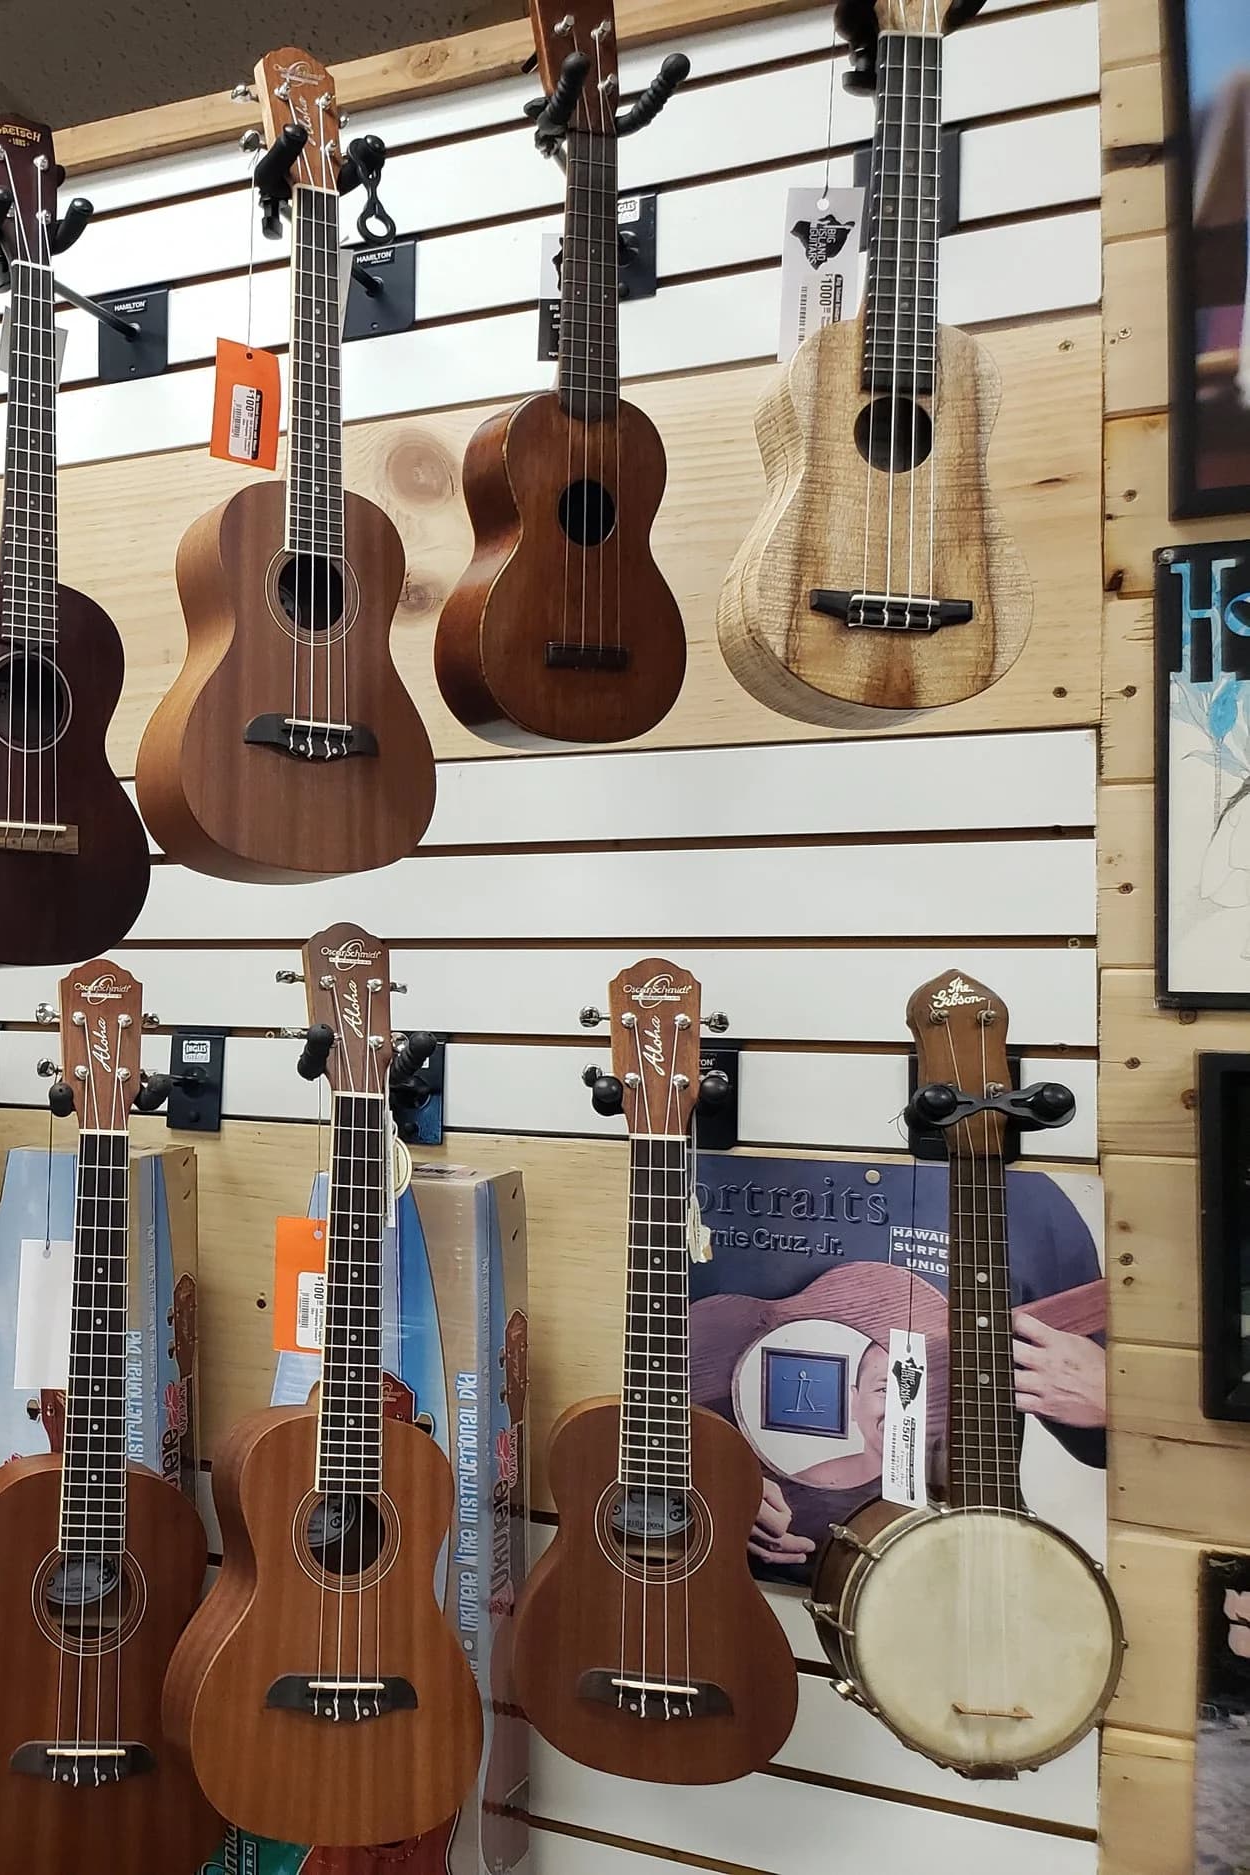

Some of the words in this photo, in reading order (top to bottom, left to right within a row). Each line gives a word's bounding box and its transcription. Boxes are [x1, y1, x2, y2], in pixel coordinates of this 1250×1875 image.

[808, 228, 819, 265] GUITARS
[817, 228, 828, 262] ISLAND
[827, 228, 837, 244] BIG
[356, 250, 393, 264] HAMILTON
[114, 300, 146, 312] HAMILTON
[931, 989, 987, 1008] Gibson
[947, 976, 975, 993] The
[342, 979, 364, 1039] Aloha
[92, 1016, 112, 1073] Aloha
[642, 1015, 666, 1076] Aloha
[692, 1176, 889, 1225] ortraits
[710, 1225, 751, 1249] rnie
[752, 1227, 812, 1257] Cruz,
[815, 1232, 845, 1256] Jr.
[905, 1257, 950, 1275] UNIO
[454, 1528, 478, 1567] Mike
